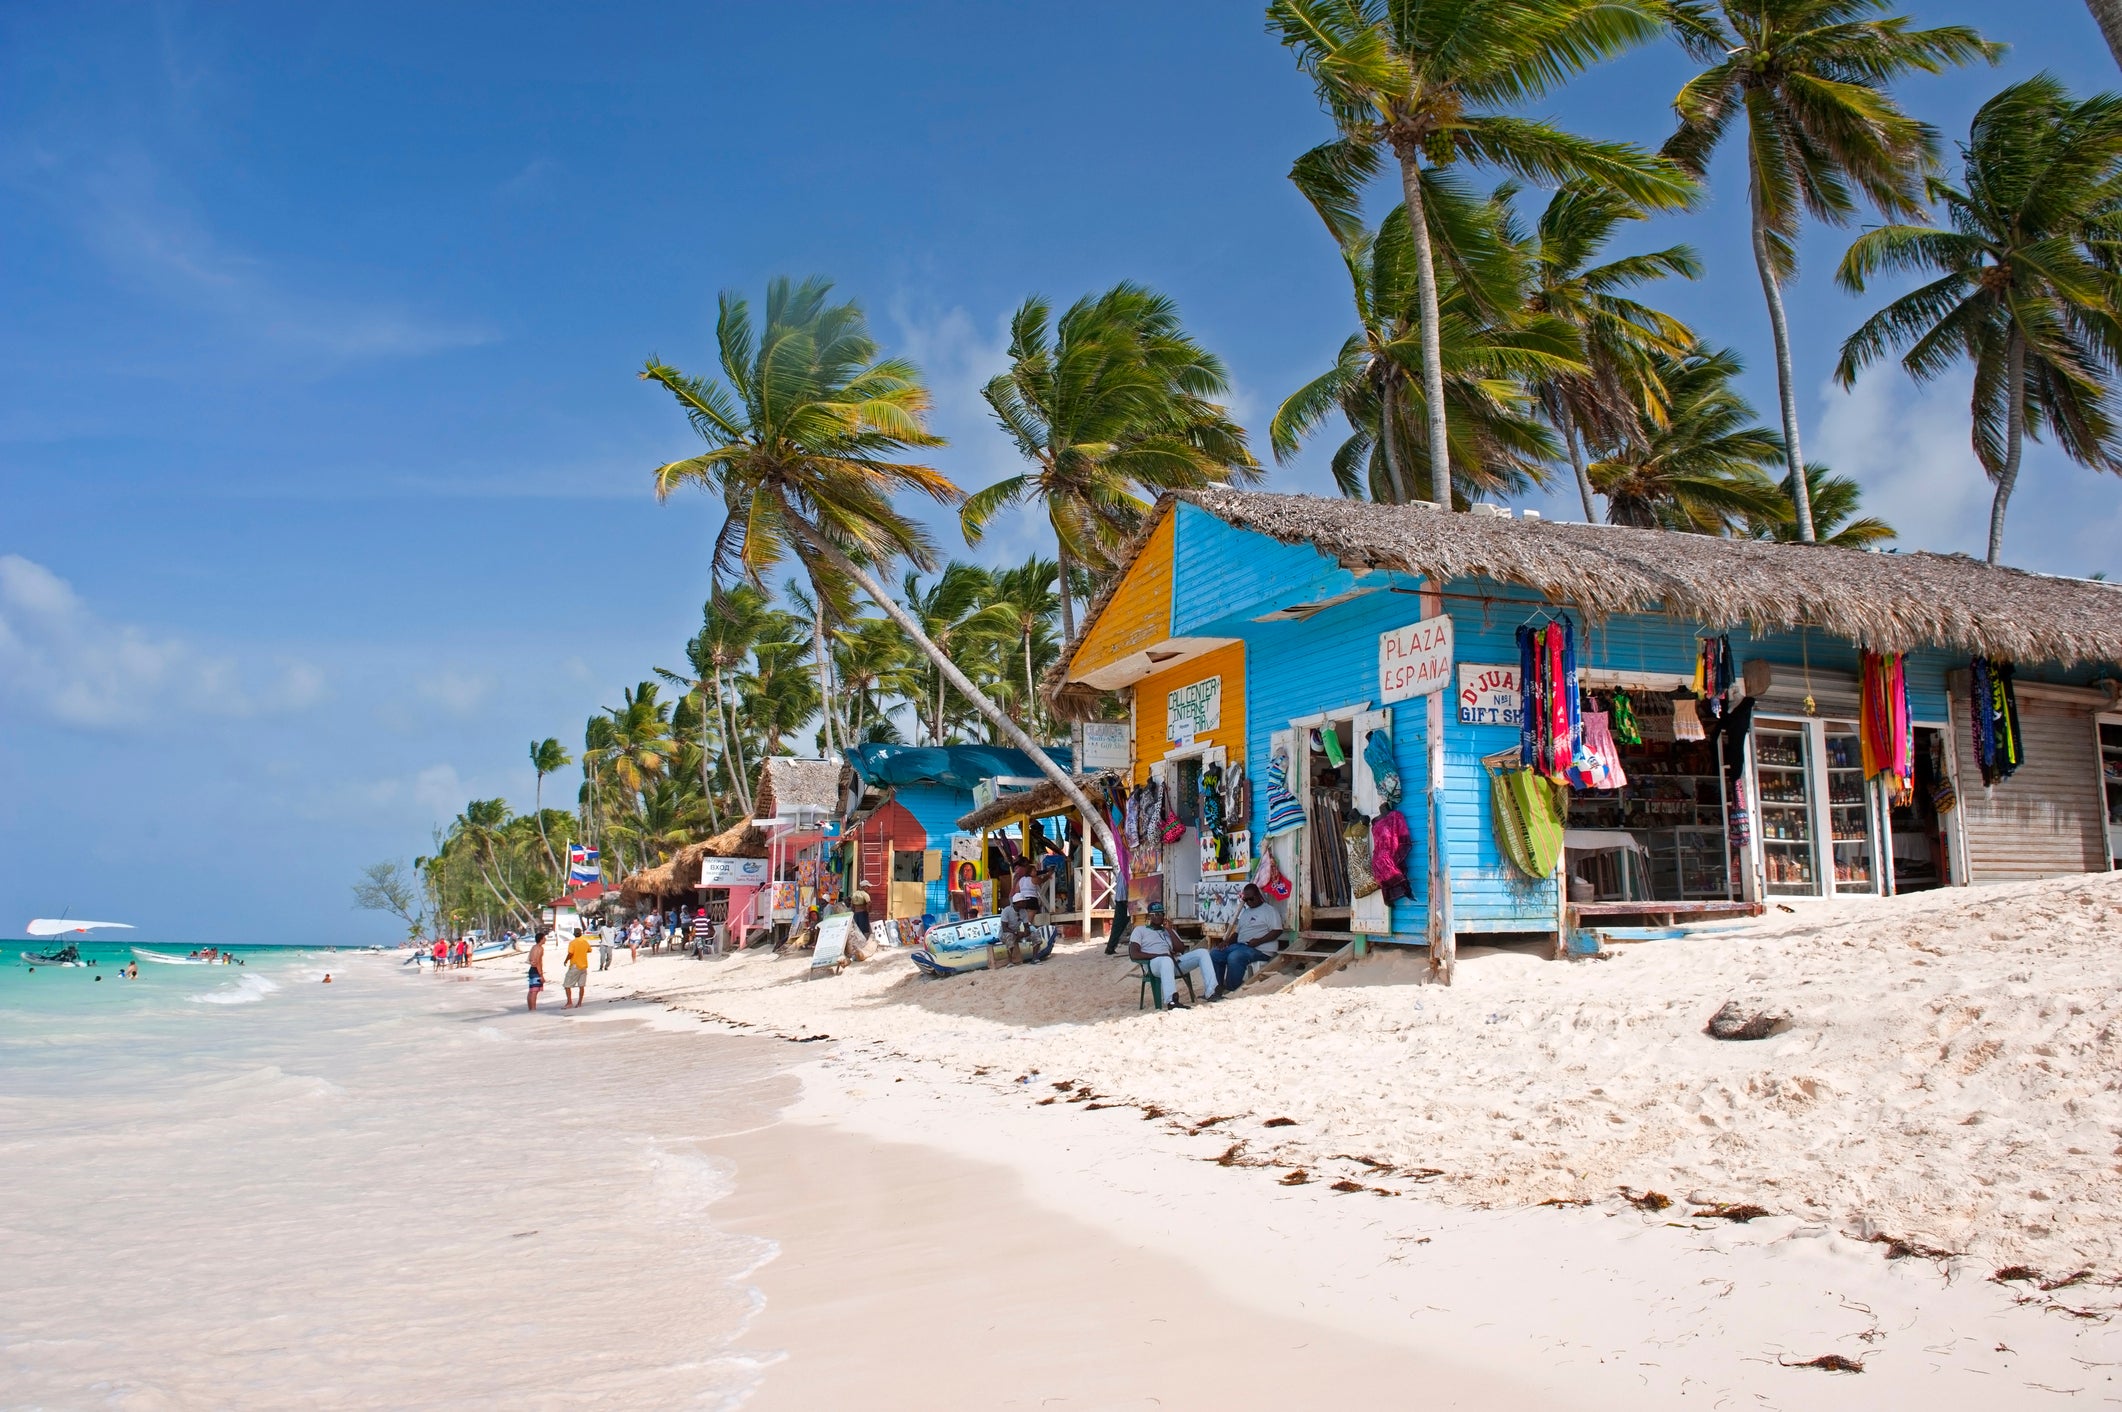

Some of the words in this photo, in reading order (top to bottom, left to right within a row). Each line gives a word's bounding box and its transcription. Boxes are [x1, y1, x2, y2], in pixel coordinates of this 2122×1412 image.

[1386, 625, 1446, 660] PLAZA
[1384, 656, 1449, 690] ESPAÑA
[1168, 688, 1184, 710] CALL
[1186, 678, 1216, 704] CENTER
[1173, 698, 1210, 723] INTERNET
[1461, 706, 1499, 723] GIFT
[1503, 708, 1524, 724] SH
